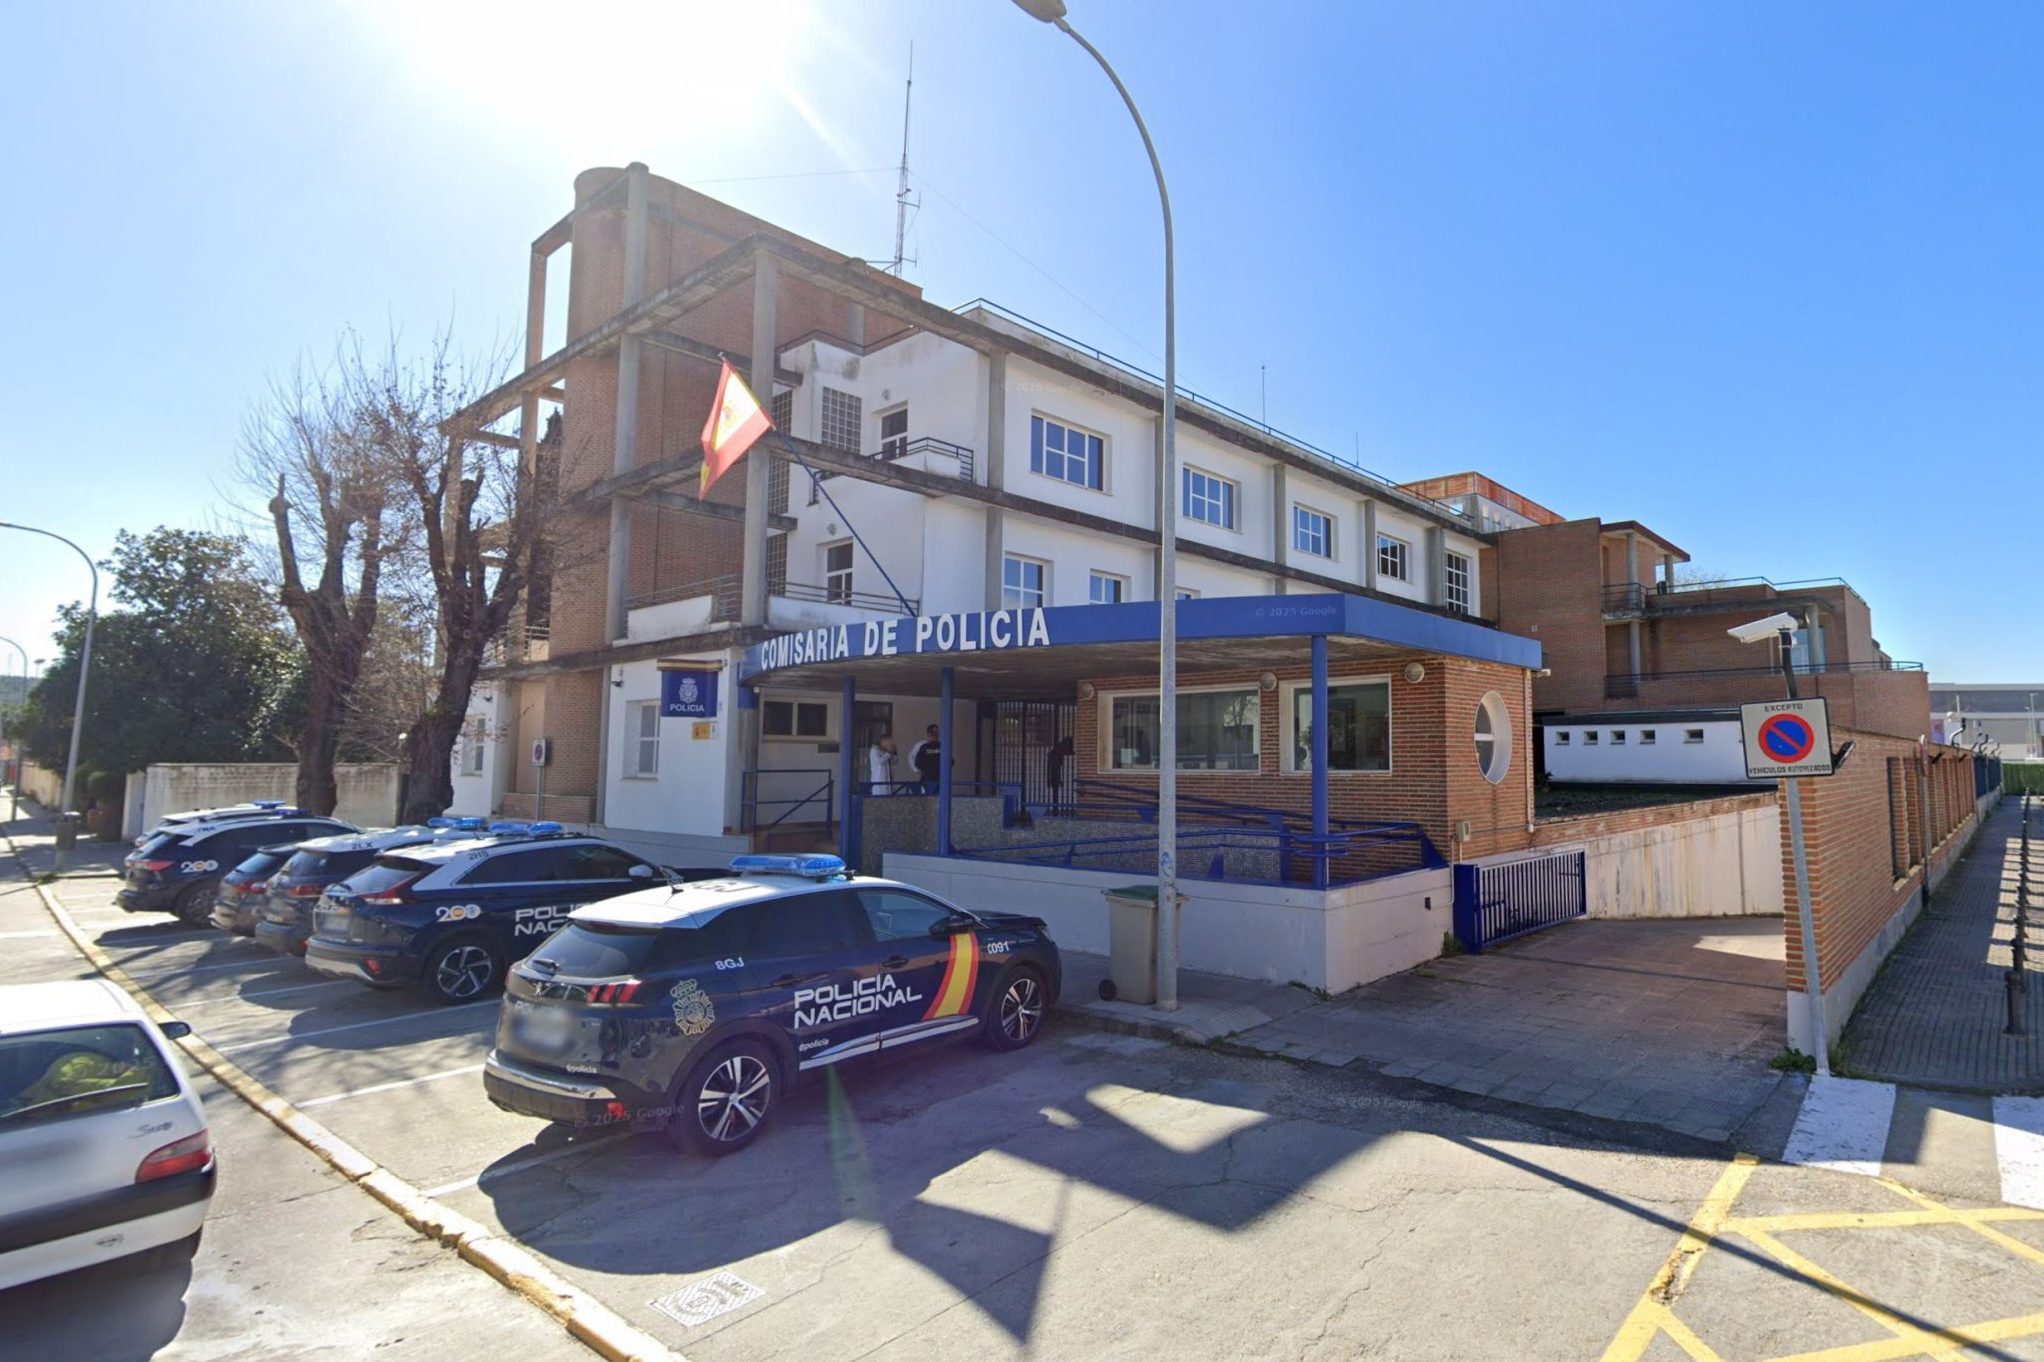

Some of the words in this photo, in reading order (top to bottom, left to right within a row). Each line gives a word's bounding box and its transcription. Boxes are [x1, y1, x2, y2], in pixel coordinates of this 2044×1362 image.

[761, 624, 849, 670] COMISARIA
[864, 619, 898, 656] DE
[916, 607, 1050, 652] POLICIA
[669, 703, 705, 713] POLICIA
[1764, 703, 1803, 712] EXCEPTO
[436, 904, 481, 922] 200
[715, 956, 745, 970] 8GJ
[794, 986, 923, 1030] NACIONAL
